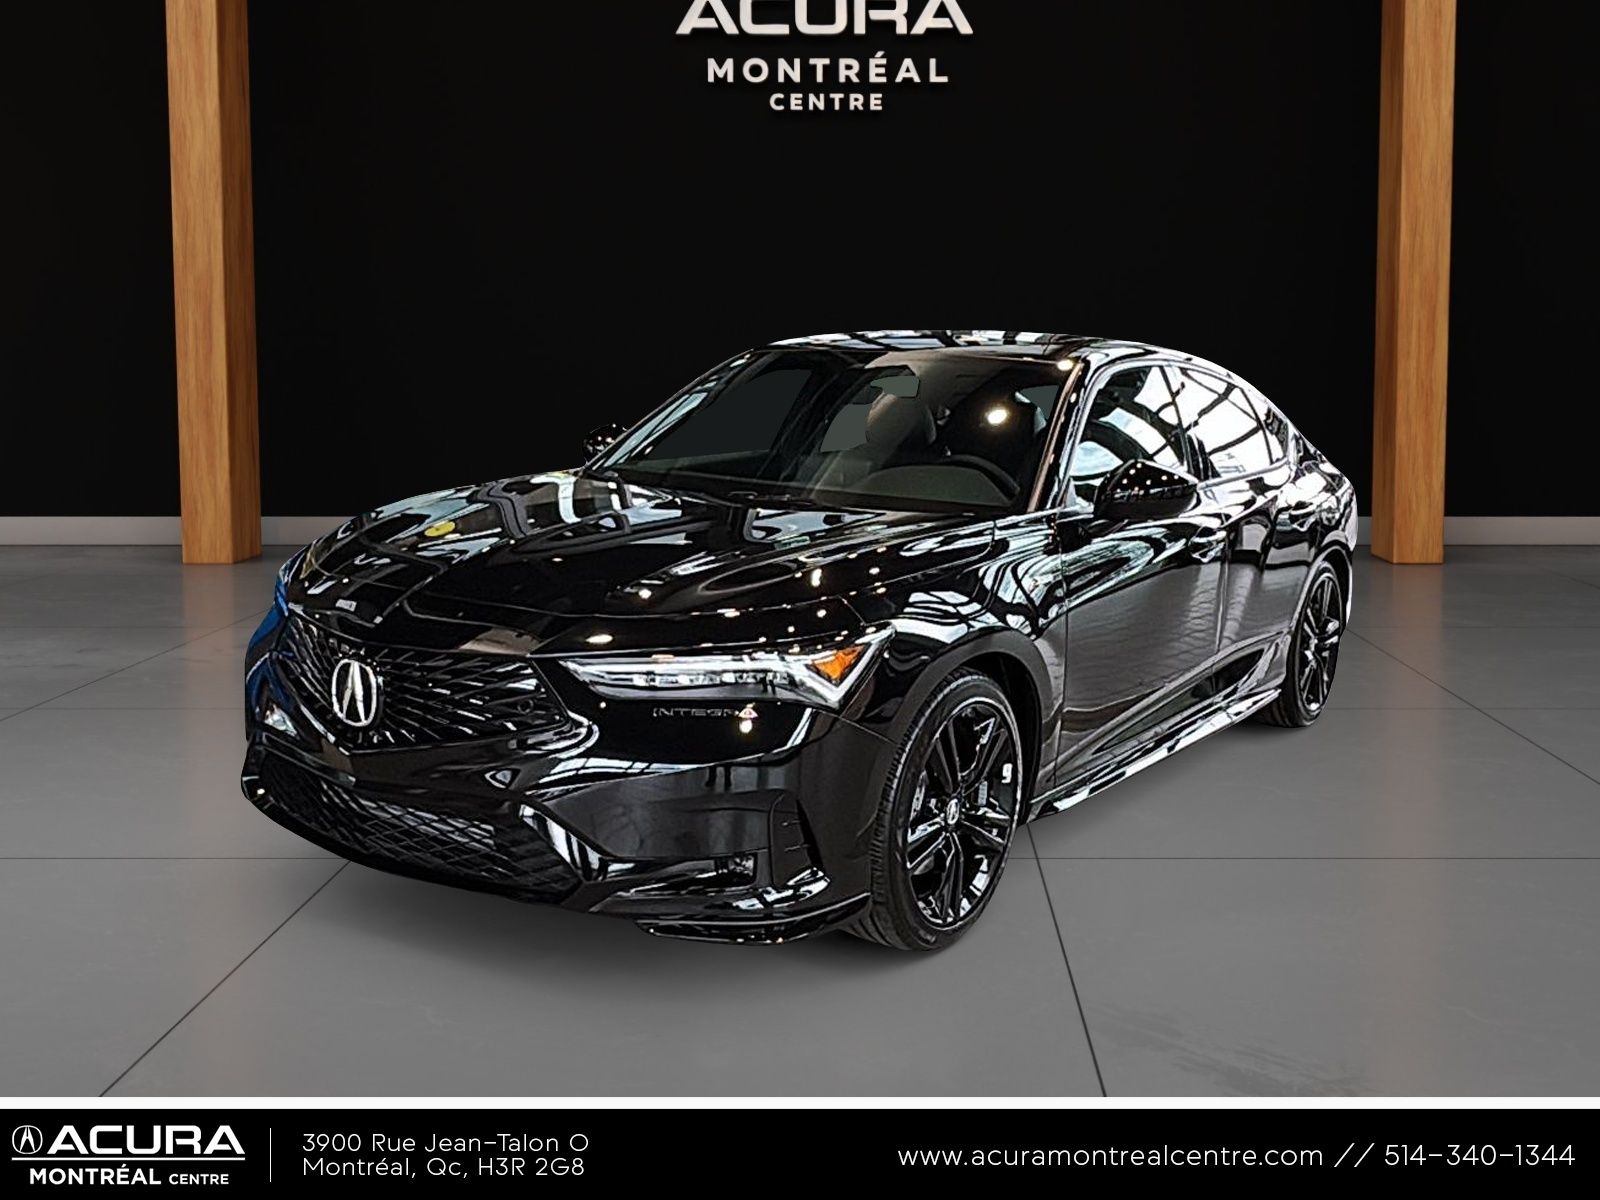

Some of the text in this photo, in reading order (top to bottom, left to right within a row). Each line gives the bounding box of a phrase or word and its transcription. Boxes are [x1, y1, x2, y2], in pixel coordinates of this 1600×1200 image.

[675, 0, 974, 35] ACURA
[707, 51, 949, 83] MONTRÉAL
[769, 93, 883, 110] CENTRE
